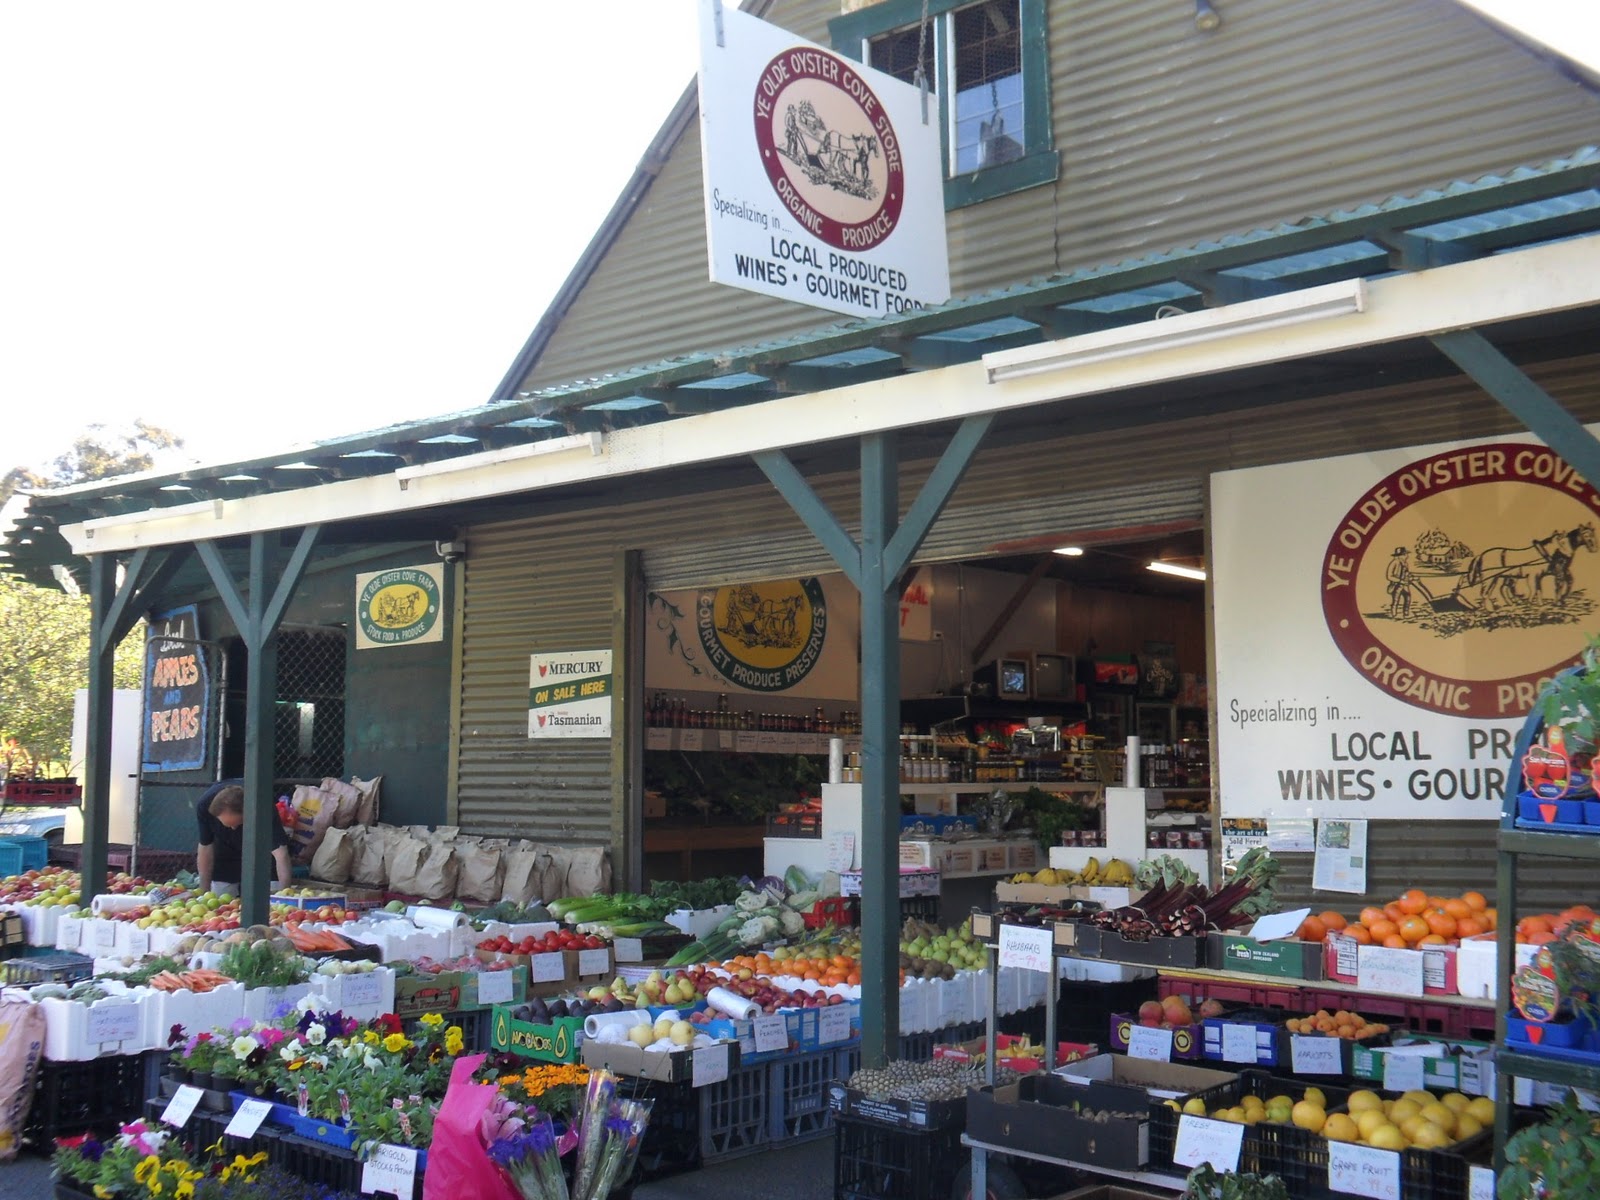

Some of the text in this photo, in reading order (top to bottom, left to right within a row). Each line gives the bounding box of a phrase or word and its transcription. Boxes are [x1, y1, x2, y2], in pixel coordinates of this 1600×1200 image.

[757, 53, 900, 172] YE OLDE OYSTER COVE STORE
[714, 188, 768, 230] Specializing
[777, 177, 892, 247] ORGANIC PRODUCE
[771, 236, 907, 291] LOCAL PRODUCED
[735, 254, 787, 286] WINES
[806, 273, 879, 310] GOURMET
[1399, 450, 1505, 497] OYSTER
[1340, 487, 1396, 551] OLDE
[362, 571, 434, 603] YE OLDE OYSTER COVE FARM
[1327, 555, 1354, 590] YE
[382, 633, 395, 641] FOOD
[401, 622, 426, 640] PRODUCE
[700, 594, 825, 688] GOURMET PRODUCE PRESERVES
[153, 654, 199, 688] APPLES
[549, 661, 603, 675] MERCURY
[1361, 646, 1471, 711] ORGANIC
[535, 680, 606, 704] ON SALE HERE
[152, 705, 200, 743] PEARS
[548, 713, 602, 726] Tasmanian
[1230, 698, 1317, 729] Specializing
[1331, 731, 1431, 761] LOCAL
[1278, 769, 1505, 801] WINES GOUR
[1229, 837, 1244, 845] Sold
[511, 1030, 552, 1051] AVOCADOS
